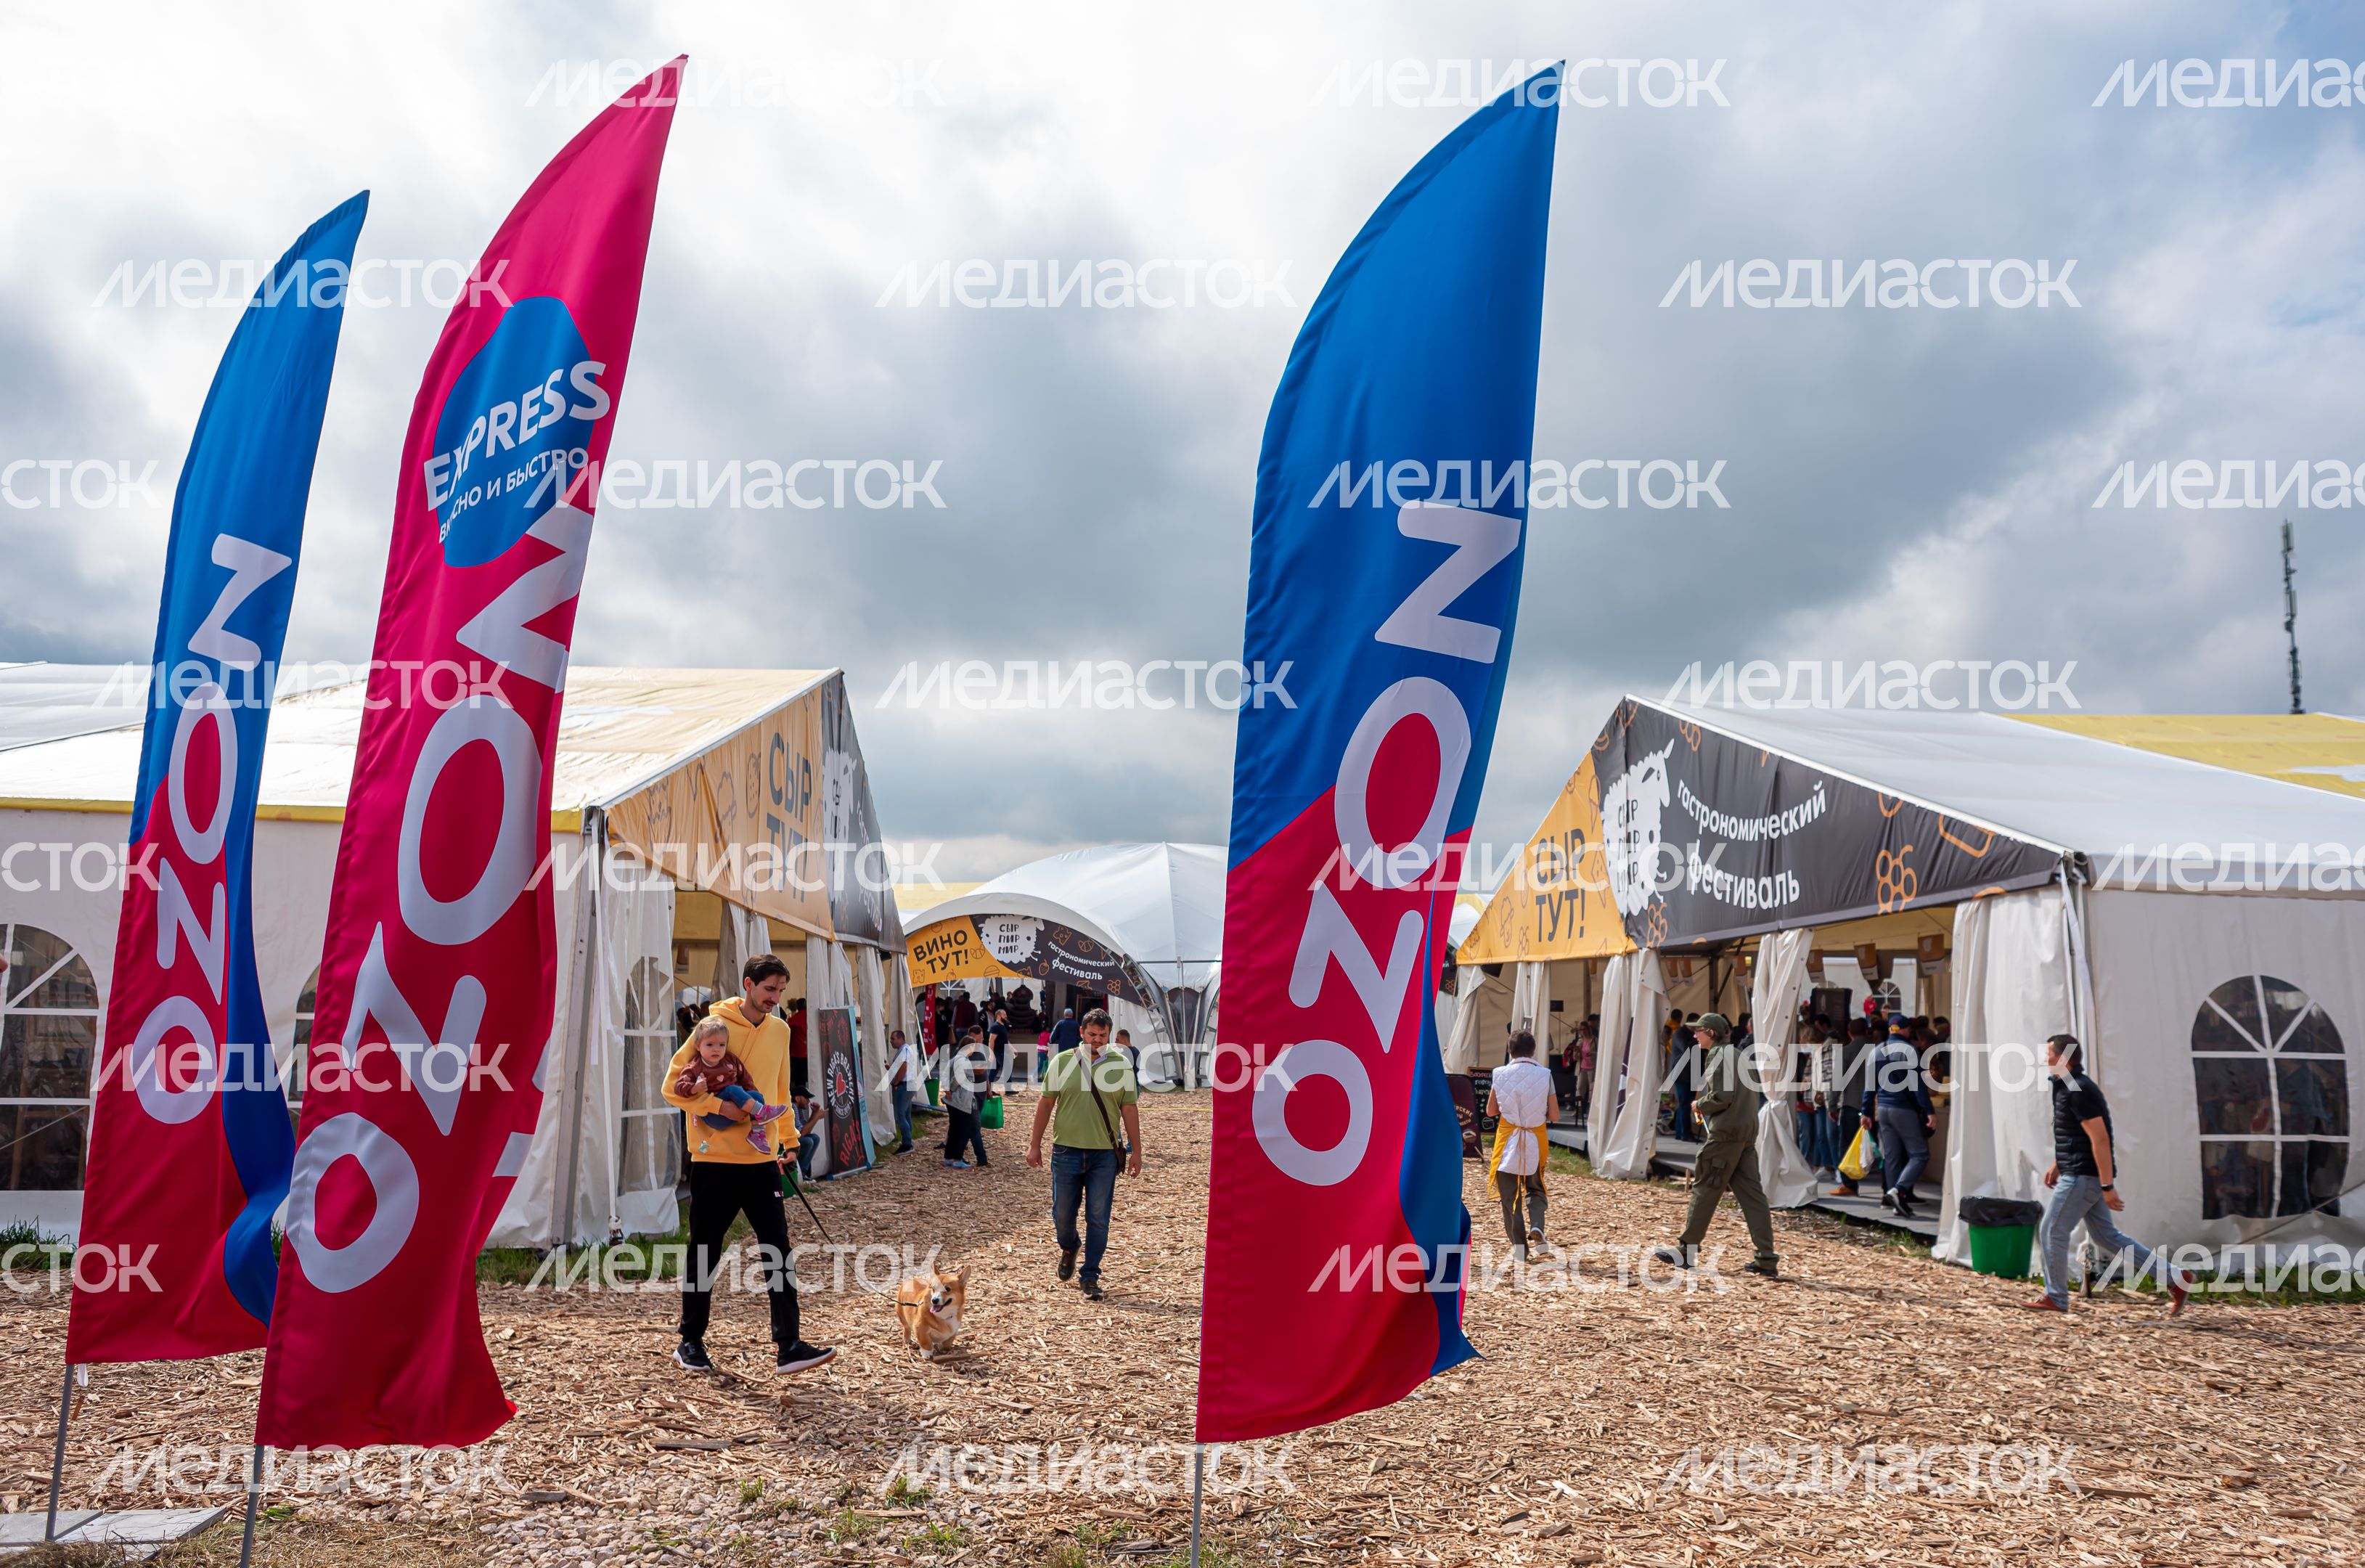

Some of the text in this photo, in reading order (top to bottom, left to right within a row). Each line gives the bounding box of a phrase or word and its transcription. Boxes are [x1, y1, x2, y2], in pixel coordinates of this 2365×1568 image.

[424, 361, 610, 511] EXPRESS
[439, 447, 589, 544] ВКСНО И БЫСТРО
[769, 732, 812, 823] СЫР
[131, 534, 292, 1124] OZON
[1677, 779, 1826, 842] гастрономический
[1252, 499, 1521, 1186] OZON
[1537, 828, 1585, 886] СЫР
[286, 499, 594, 1293] OZON
[1688, 839, 1800, 910] фестиваль
[998, 934, 1020, 944] ПИР
[999, 923, 1019, 933] СЫР
[1535, 887, 1585, 942] ТУТ!
[912, 929, 968, 962] ВИНО
[926, 949, 969, 975] ТУТ!
[997, 944, 1019, 955] МИР
[1047, 941, 1116, 968] гастрономический
[1052, 957, 1103, 981] фестиваль
